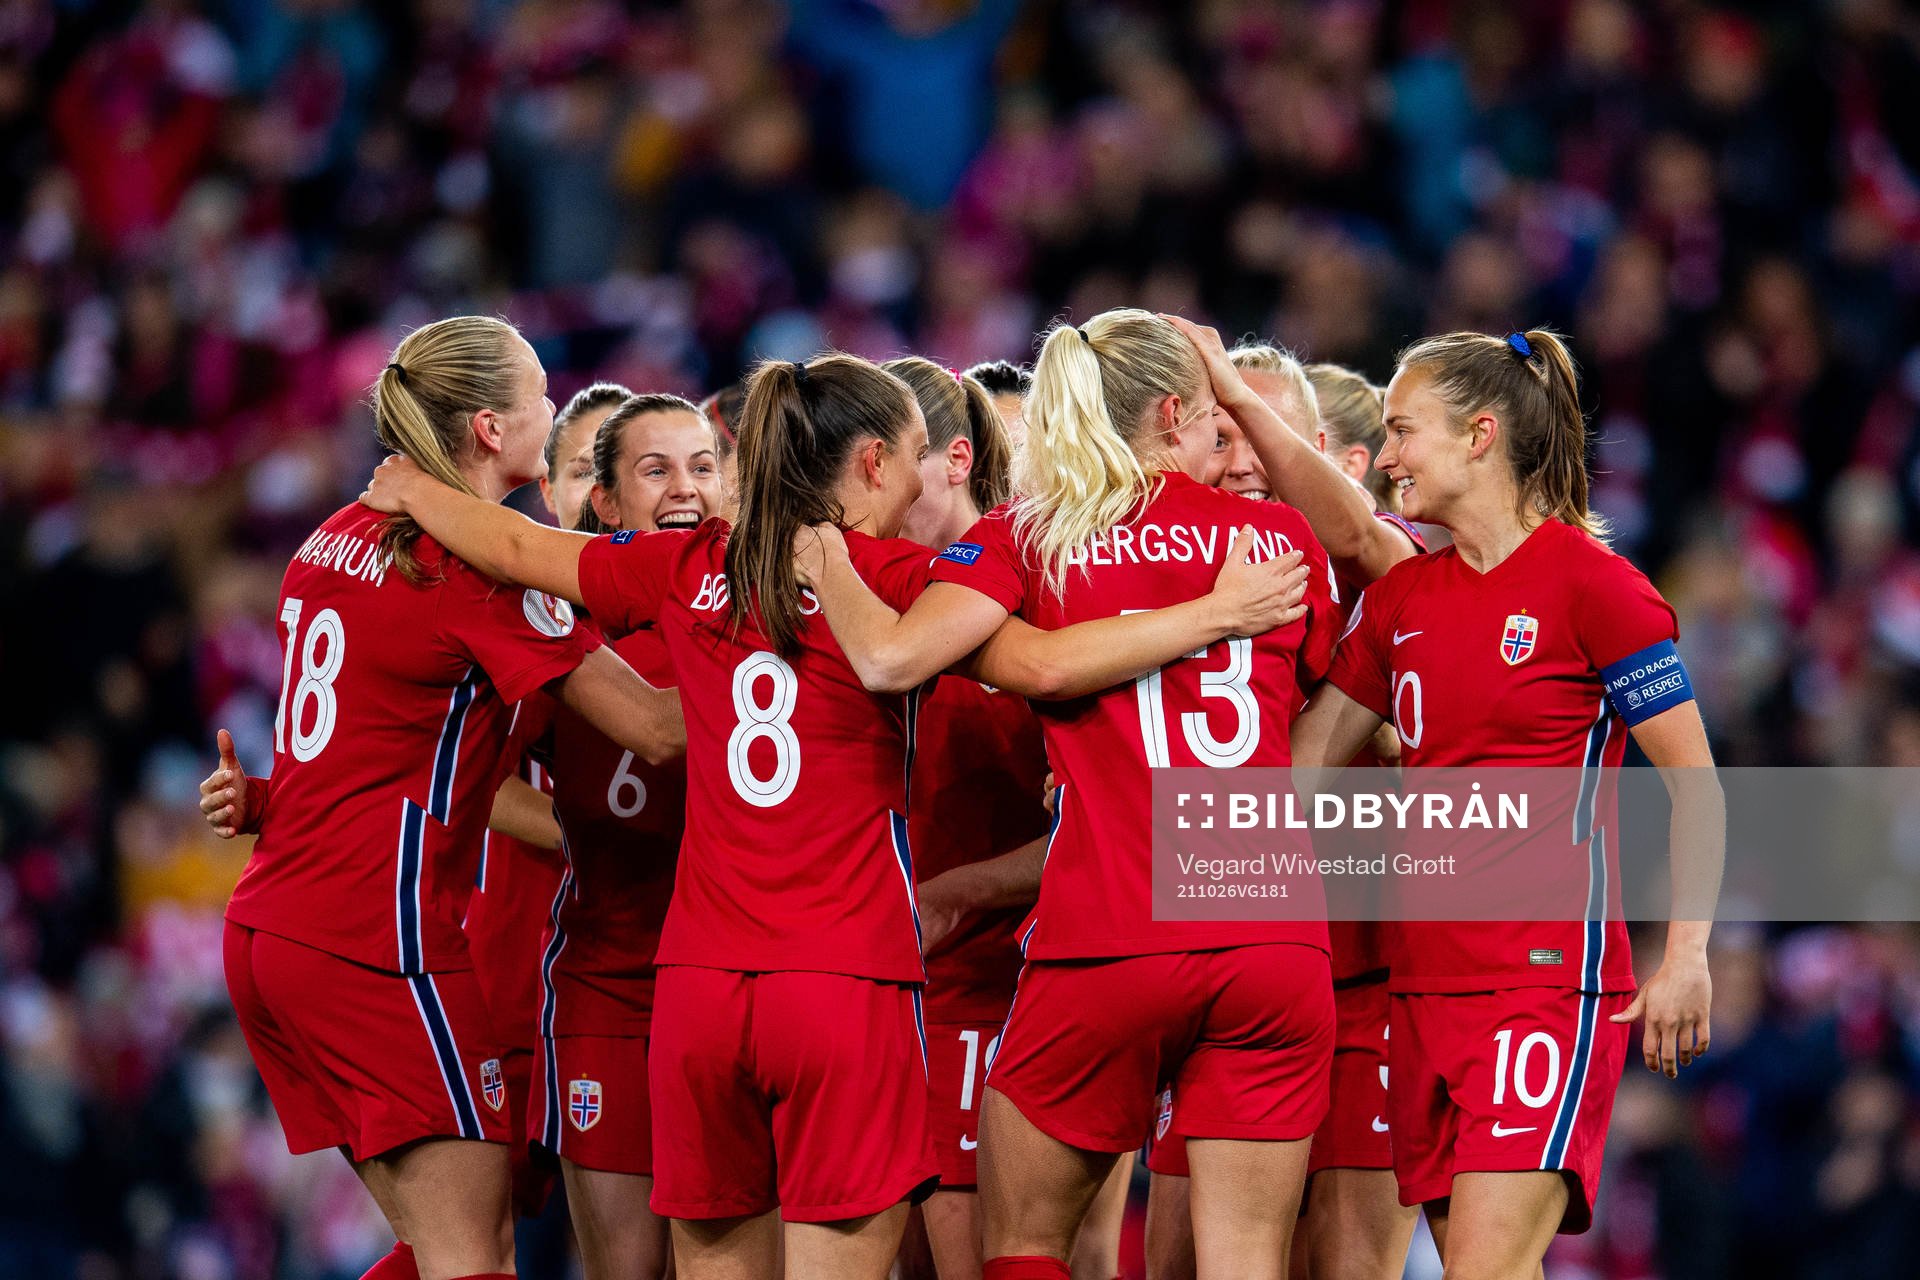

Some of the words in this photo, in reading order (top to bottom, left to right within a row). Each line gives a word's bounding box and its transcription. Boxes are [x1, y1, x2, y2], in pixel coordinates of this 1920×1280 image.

[293, 528, 394, 588] MAANUM
[274, 597, 346, 763] 18
[1119, 609, 1261, 769] 13
[1392, 671, 1423, 749] 0
[1612, 676, 1630, 690] NO
[1629, 668, 1646, 681] TO
[1642, 673, 1683, 699] RESPECT
[727, 650, 801, 808] 8
[607, 748, 647, 818] 6
[958, 1029, 1000, 1110] 1
[1492, 1029, 1560, 1109] 10
